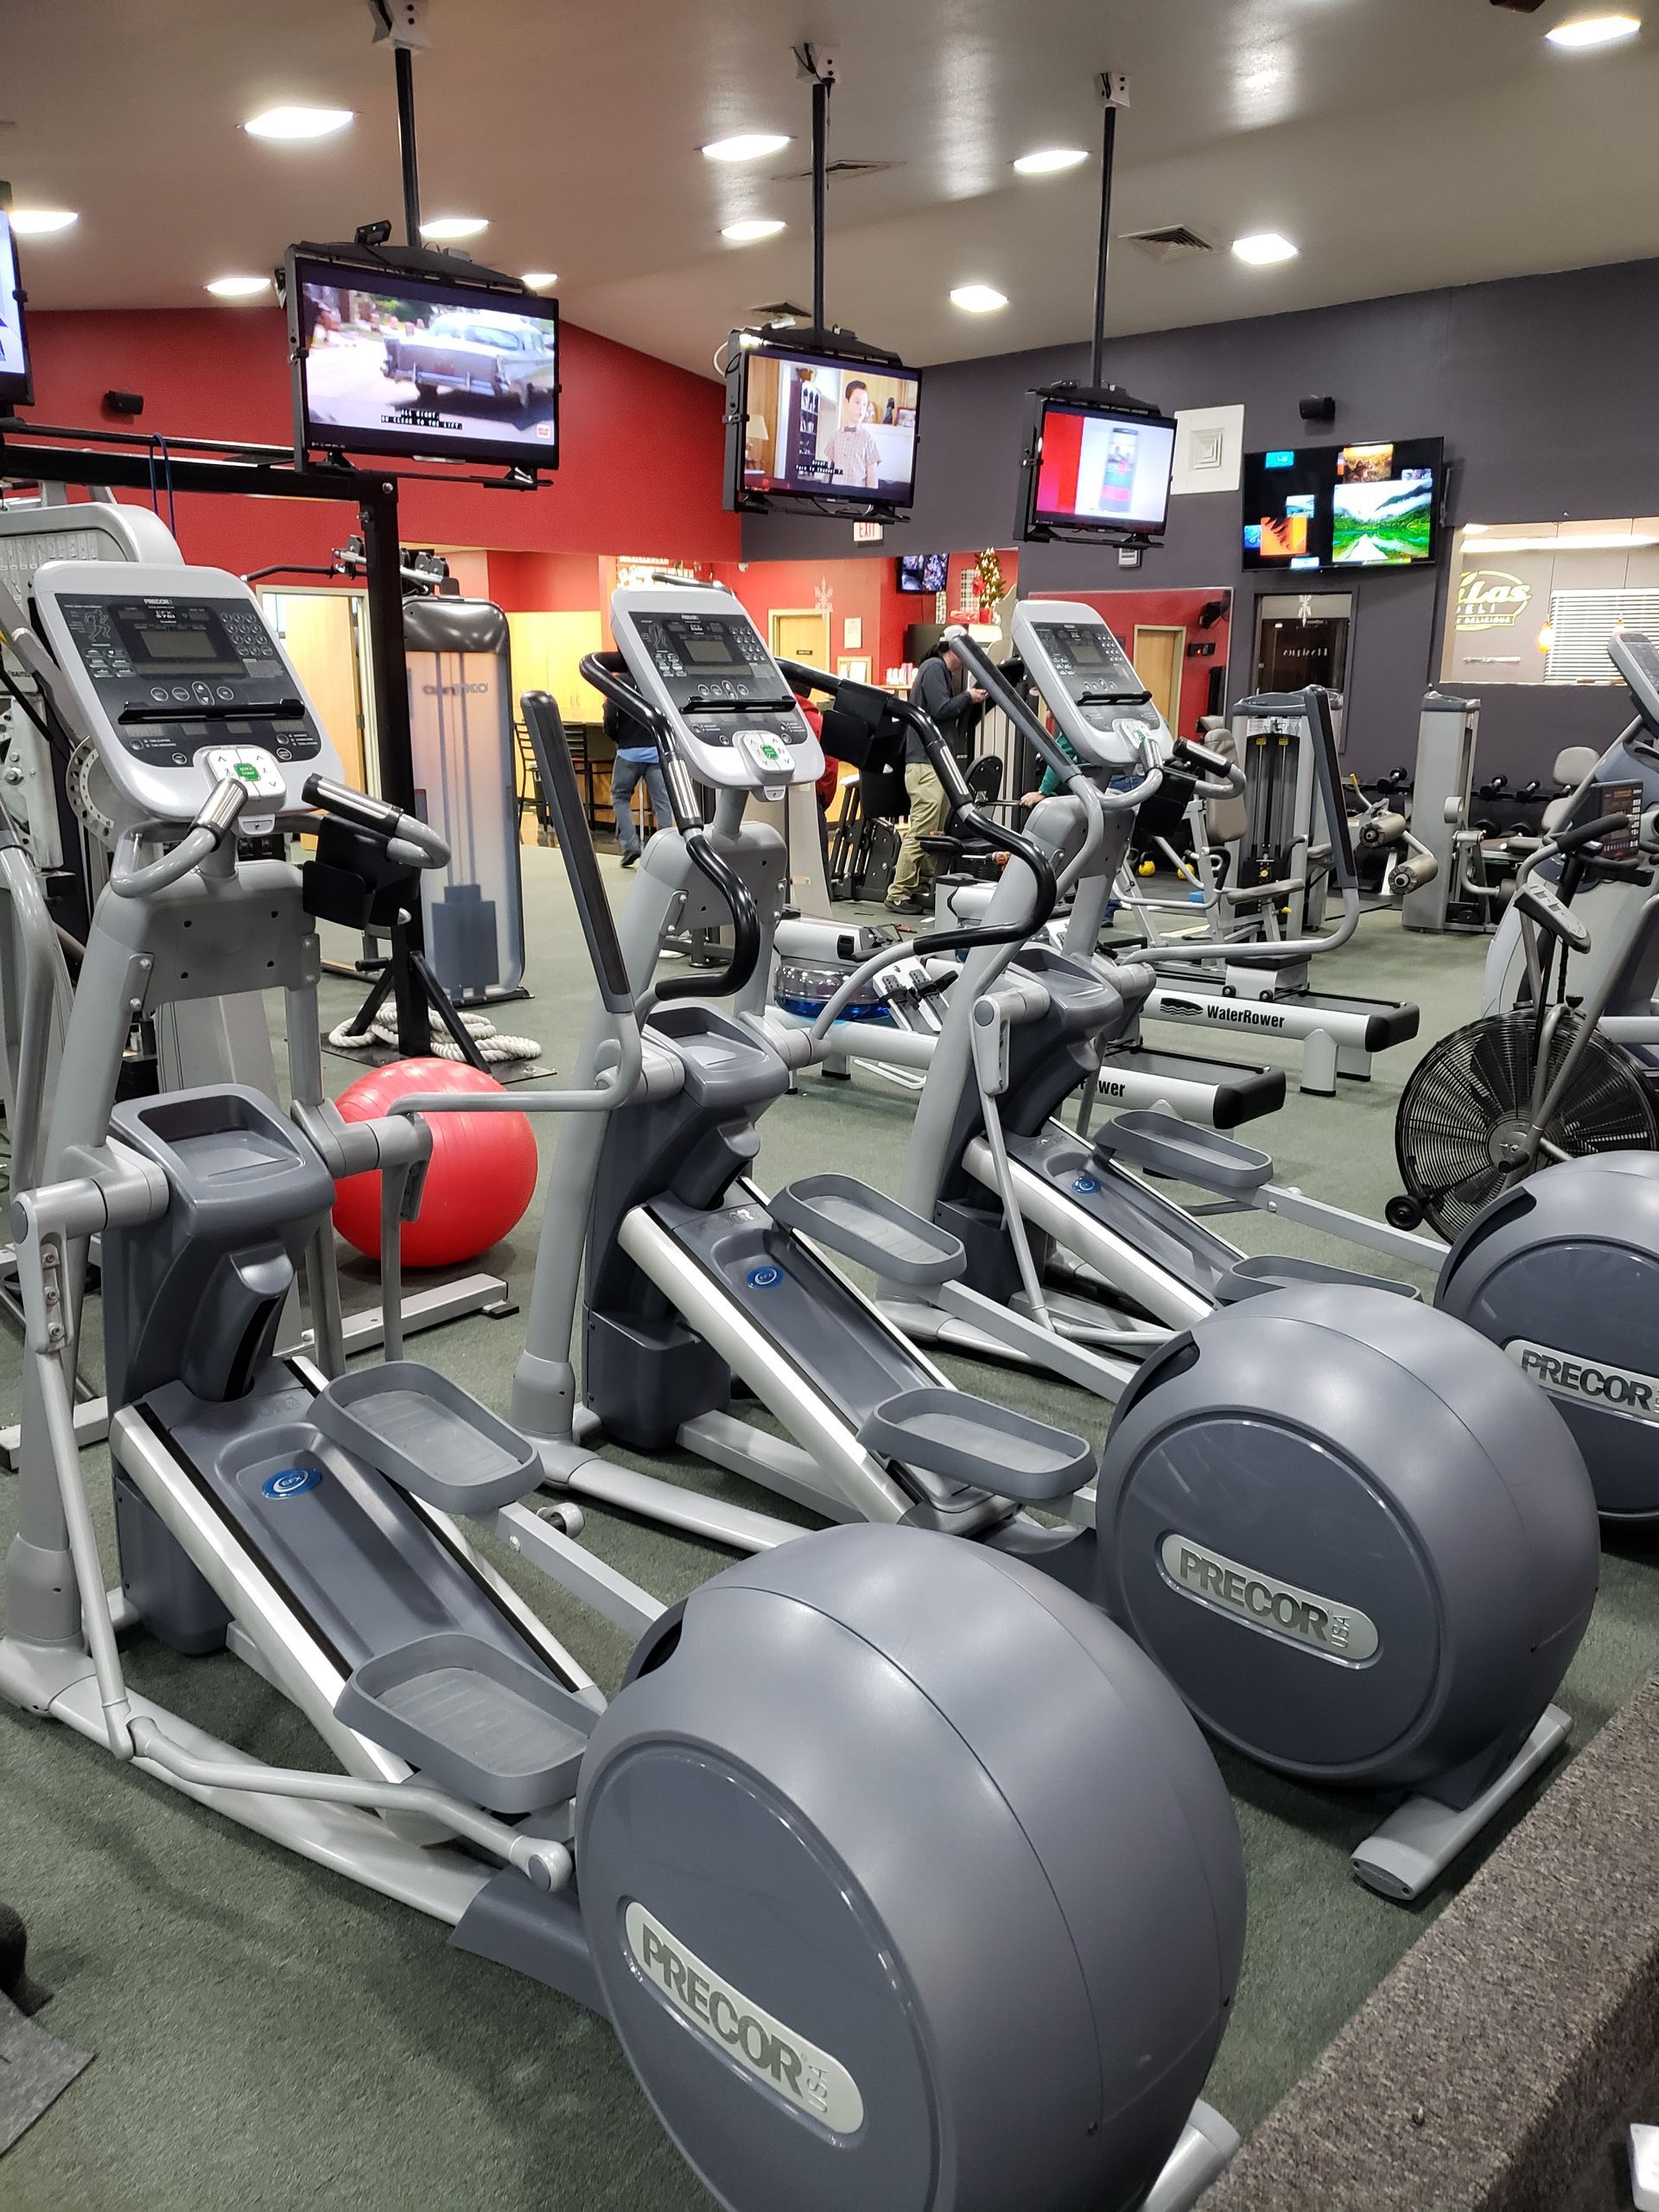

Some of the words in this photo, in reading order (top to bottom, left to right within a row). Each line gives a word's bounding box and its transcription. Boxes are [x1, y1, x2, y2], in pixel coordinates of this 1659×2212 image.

[859, 522, 875, 537] EXIT
[1207, 1004, 1285, 1028] WaterRower
[1521, 1349, 1653, 1411] PRECOR
[1180, 1548, 1329, 1642] PRECOR
[1332, 1614, 1351, 1649] USA
[643, 1923, 804, 2099] PRECOR
[807, 2064, 830, 2113] USA
